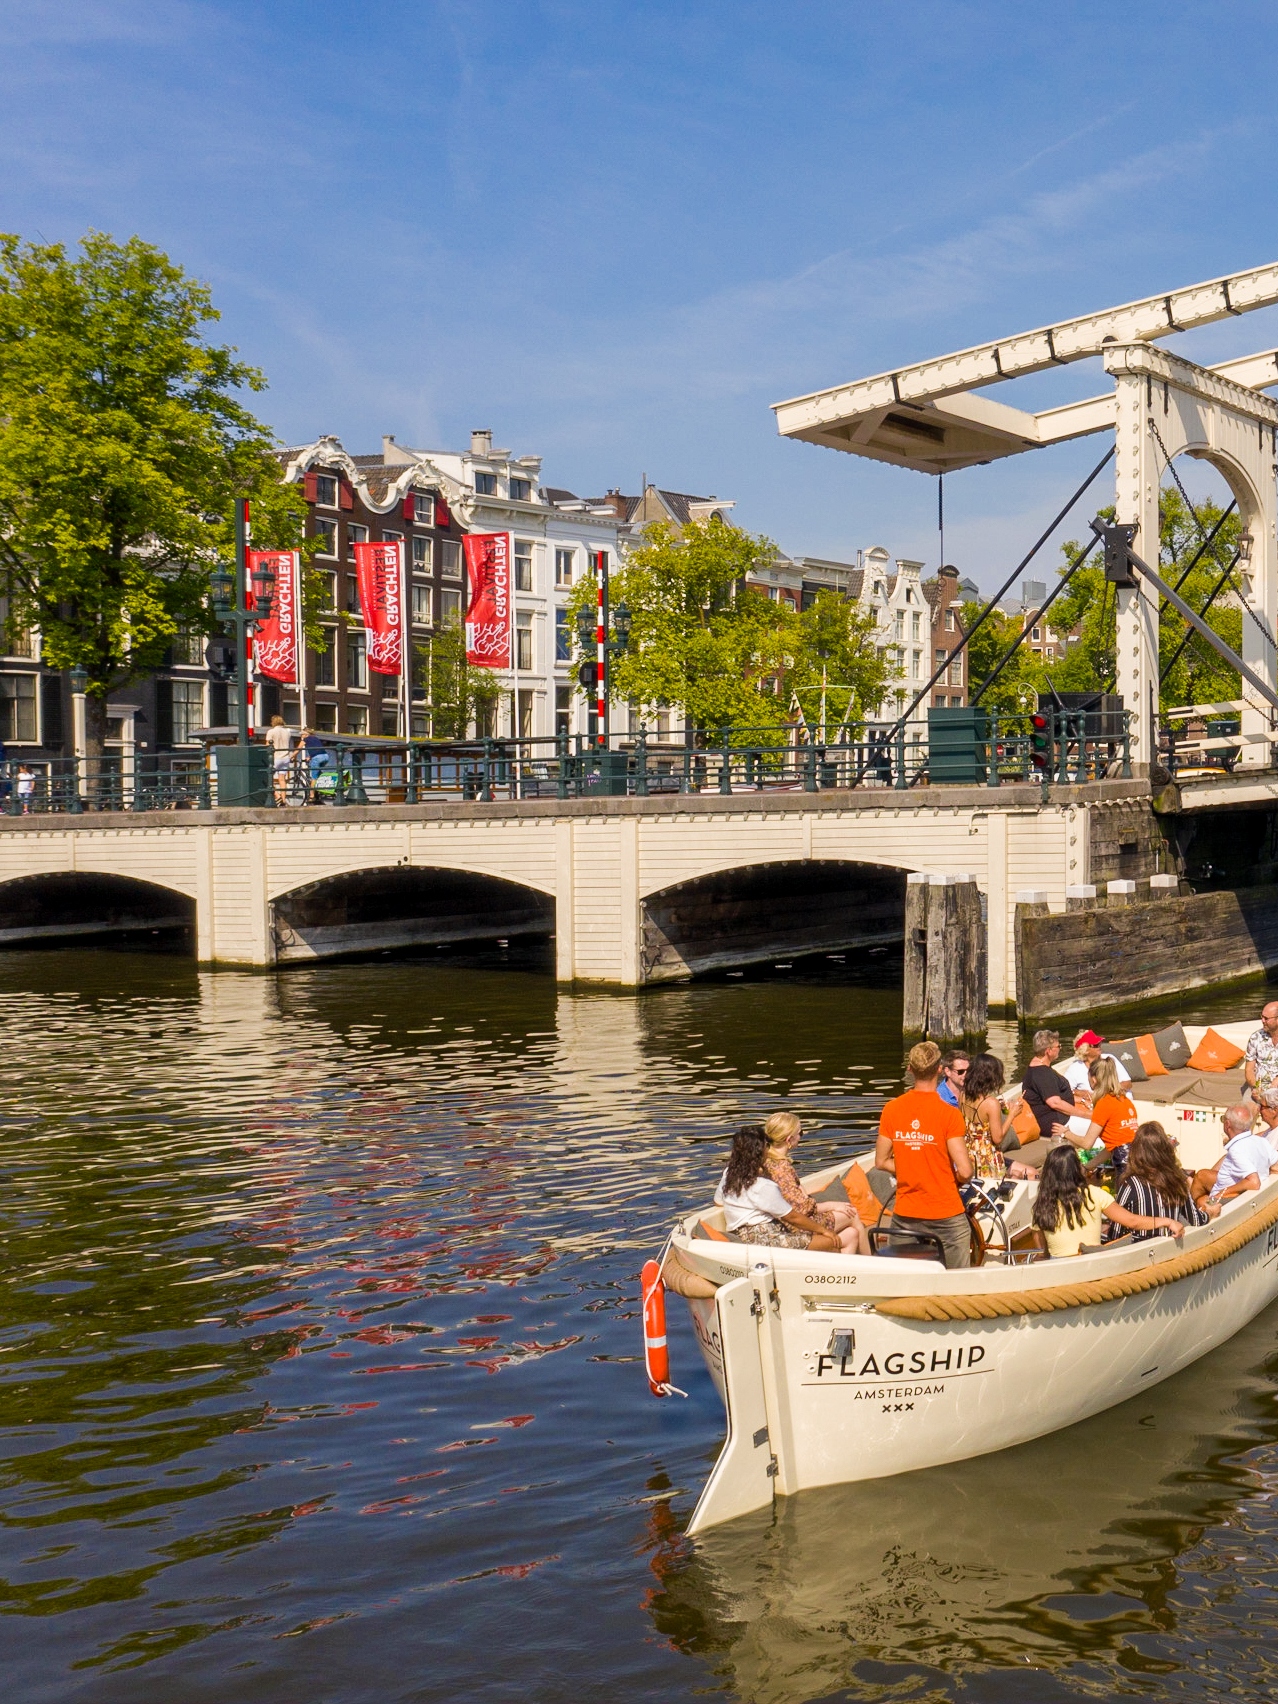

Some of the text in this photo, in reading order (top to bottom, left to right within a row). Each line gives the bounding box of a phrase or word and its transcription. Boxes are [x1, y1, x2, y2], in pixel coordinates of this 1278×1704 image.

[804, 1275, 857, 1285] 03802112
[816, 1345, 986, 1377] FLAGSHIP
[854, 1384, 945, 1400] AMSTERDAM
